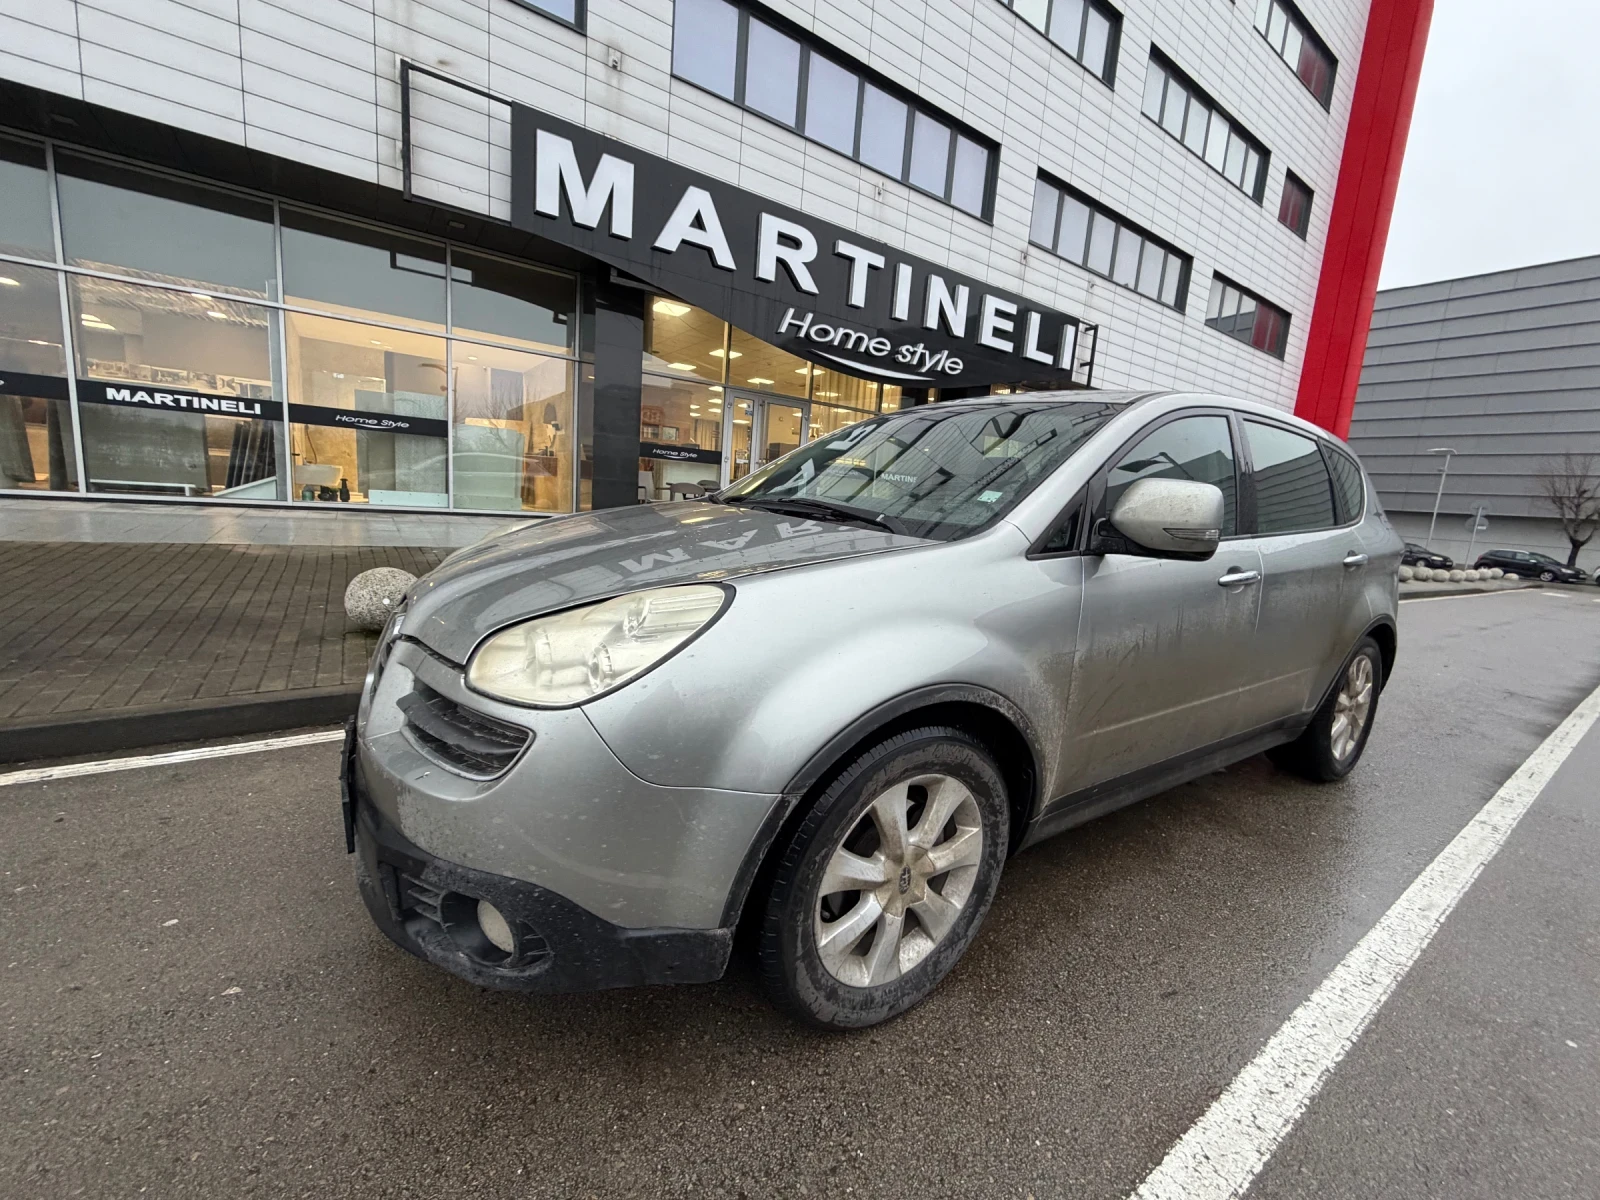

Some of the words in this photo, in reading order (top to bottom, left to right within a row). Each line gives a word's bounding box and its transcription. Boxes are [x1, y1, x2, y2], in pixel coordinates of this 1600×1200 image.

[534, 128, 1076, 371] MARTINELI
[777, 307, 892, 357] Home
[896, 342, 964, 375] style
[105, 387, 261, 415] MARTINELI
[335, 414, 379, 425] Home
[380, 419, 410, 429] Style
[652, 448, 679, 456] Home
[679, 451, 698, 459] Style
